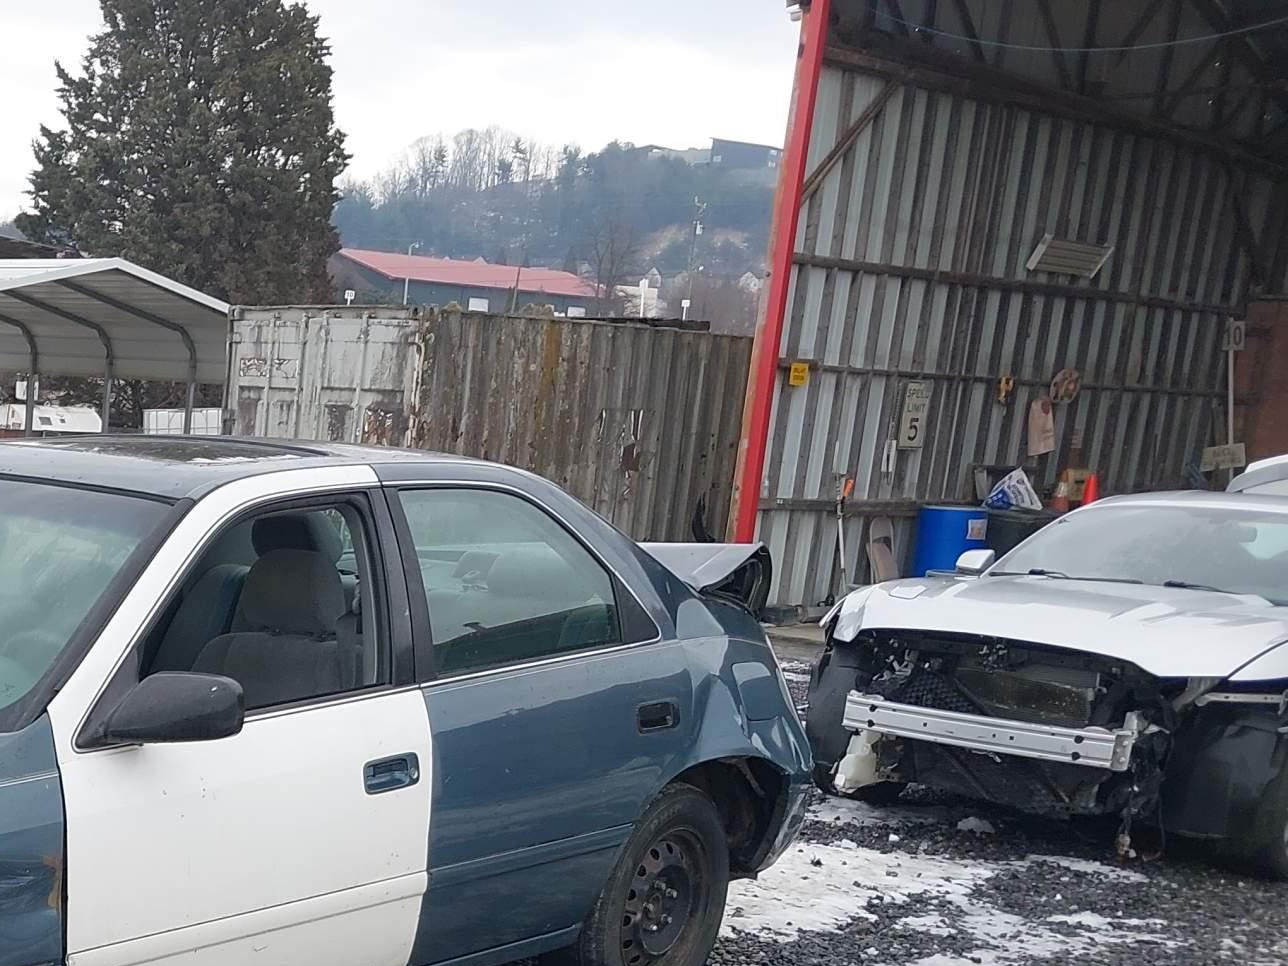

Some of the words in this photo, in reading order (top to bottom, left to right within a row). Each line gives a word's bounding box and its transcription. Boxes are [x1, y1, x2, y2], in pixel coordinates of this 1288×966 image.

[1225, 326, 1242, 346] 10
[907, 403, 925, 413] LIMIT
[907, 417, 919, 442] 5
